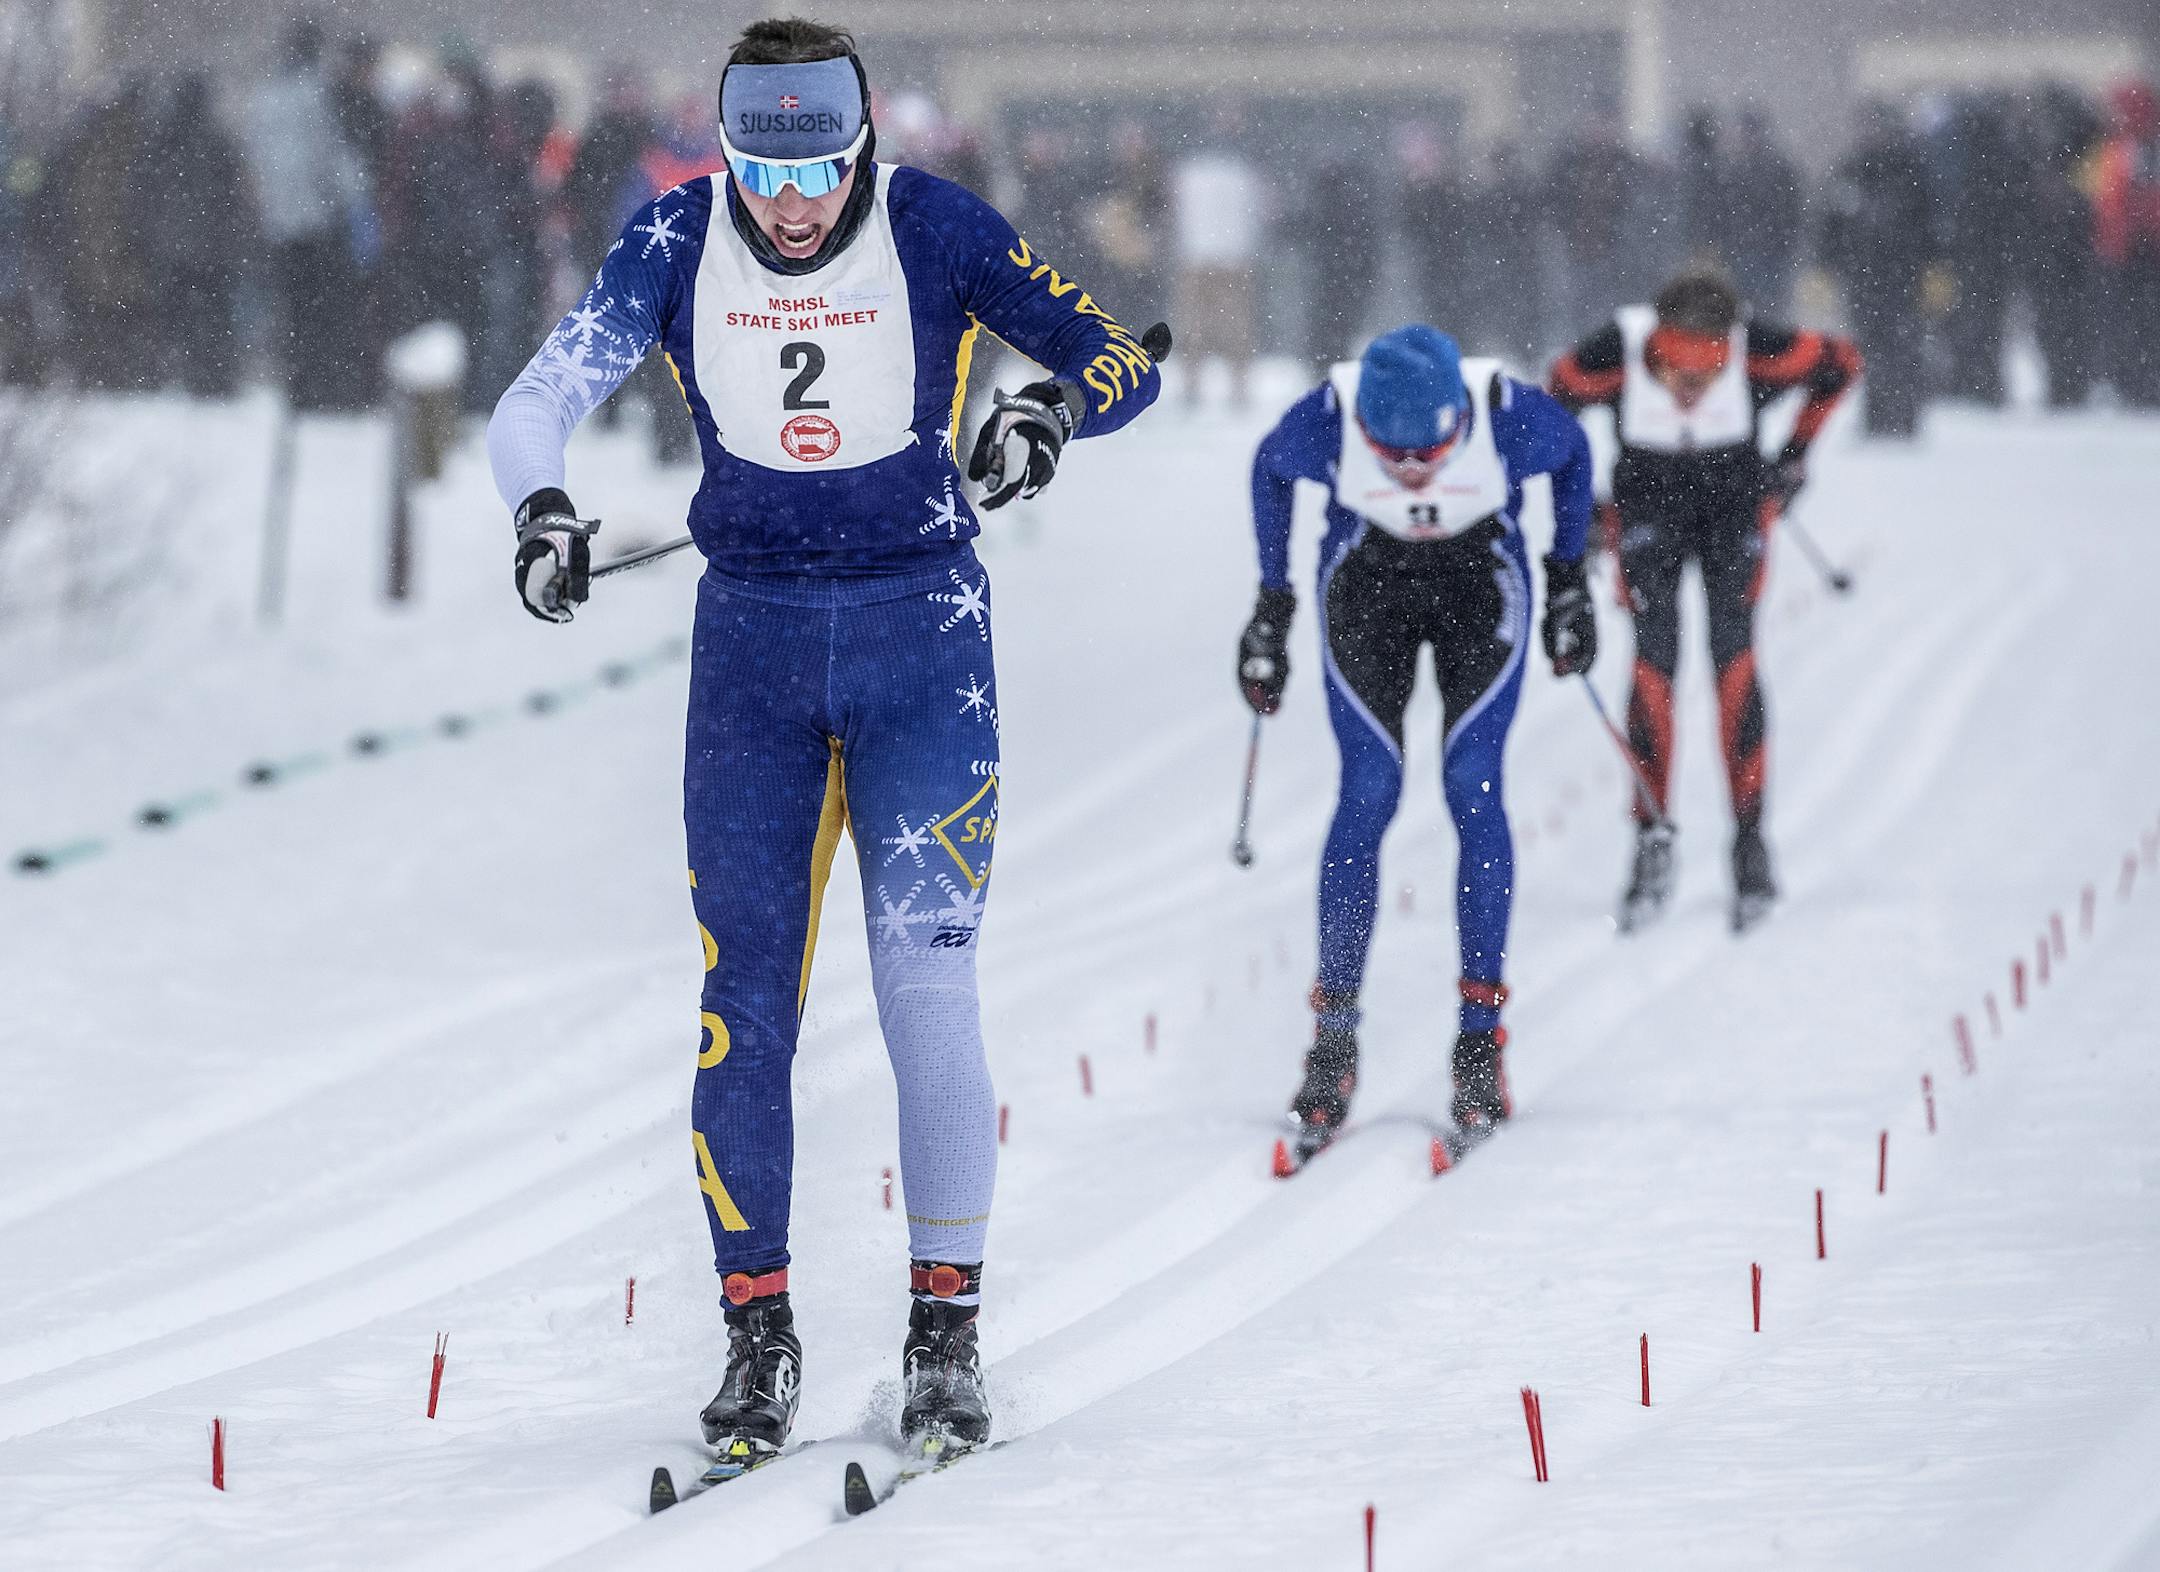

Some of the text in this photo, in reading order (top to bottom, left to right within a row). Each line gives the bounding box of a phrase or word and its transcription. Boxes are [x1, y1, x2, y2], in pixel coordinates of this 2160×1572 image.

[740, 112, 842, 134] SJUSJØEN
[768, 296, 829, 312] MSHSL
[726, 310, 878, 331] STATE SKI MEET
[780, 341, 830, 411] 2
